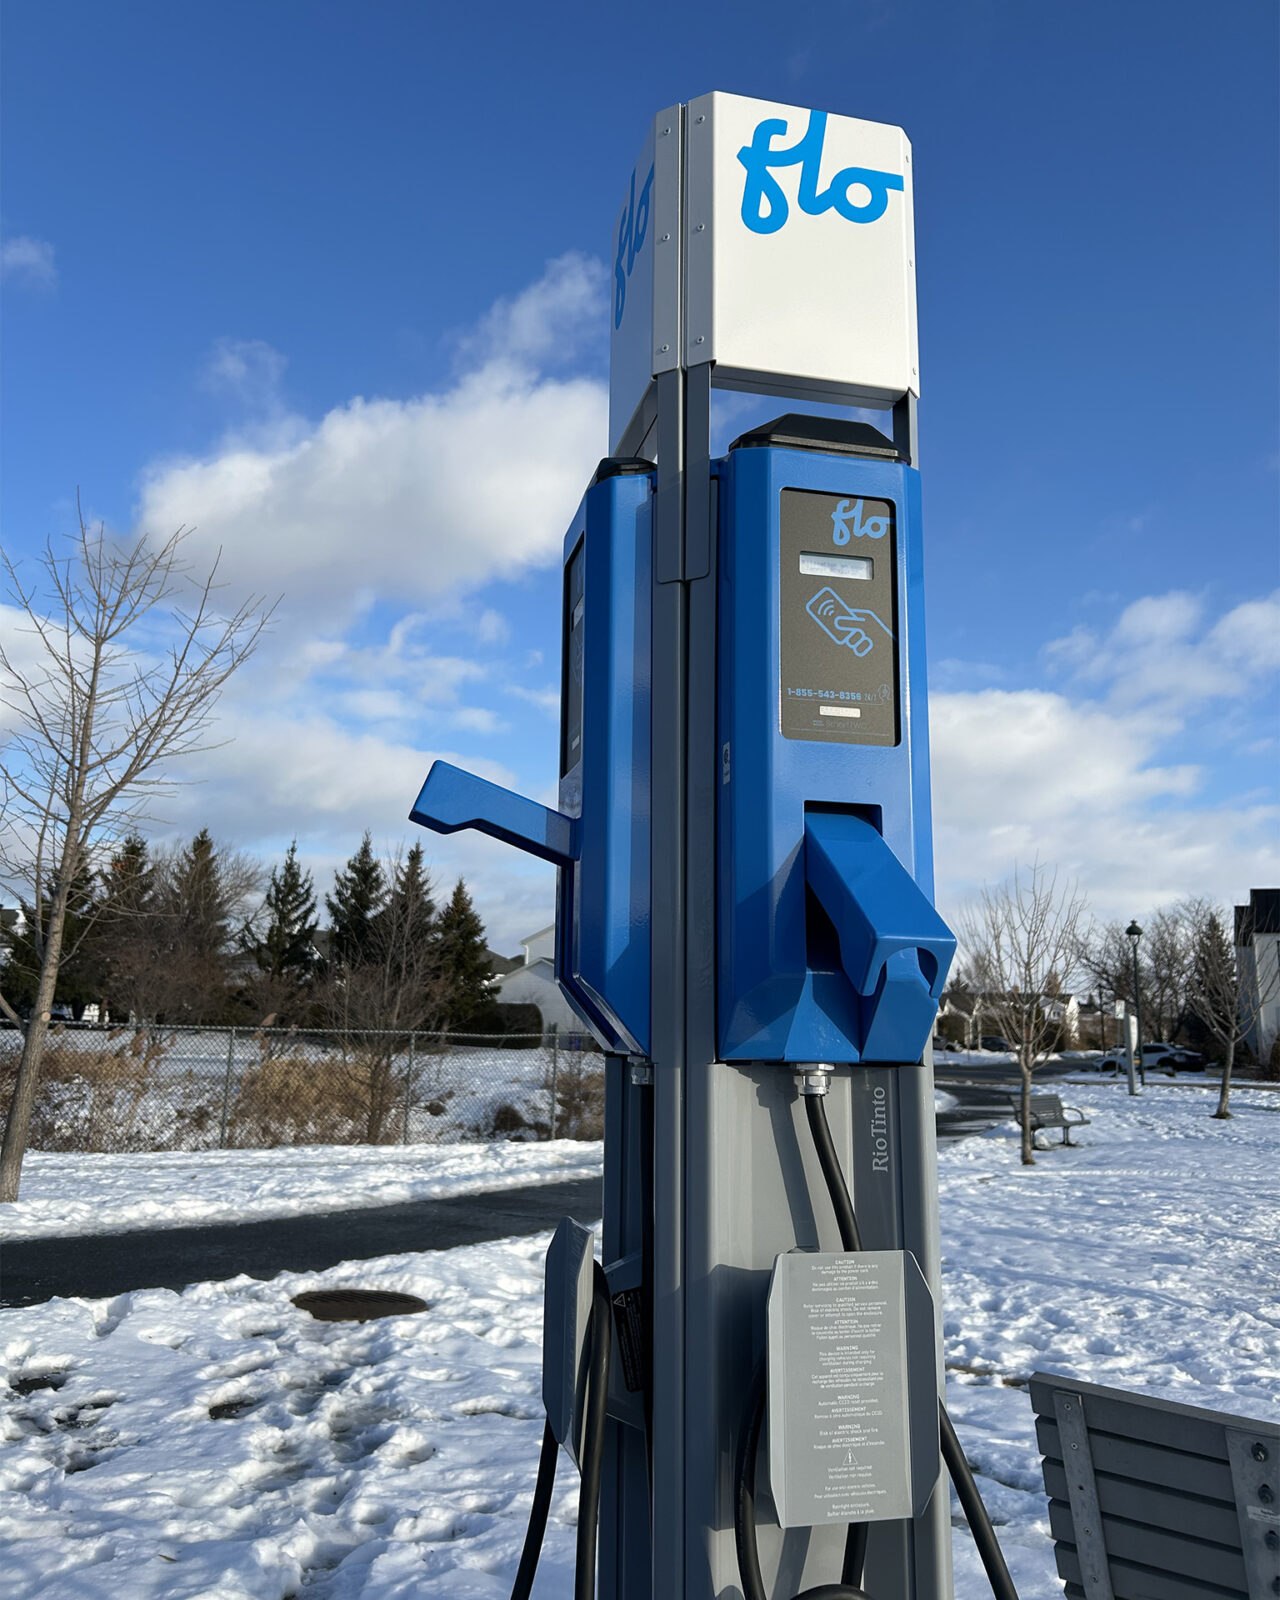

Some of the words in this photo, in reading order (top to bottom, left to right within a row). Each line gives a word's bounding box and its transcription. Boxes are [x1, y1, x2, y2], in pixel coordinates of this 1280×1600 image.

[736, 110, 904, 235] flo
[615, 162, 654, 330] flo
[831, 498, 894, 546] flo
